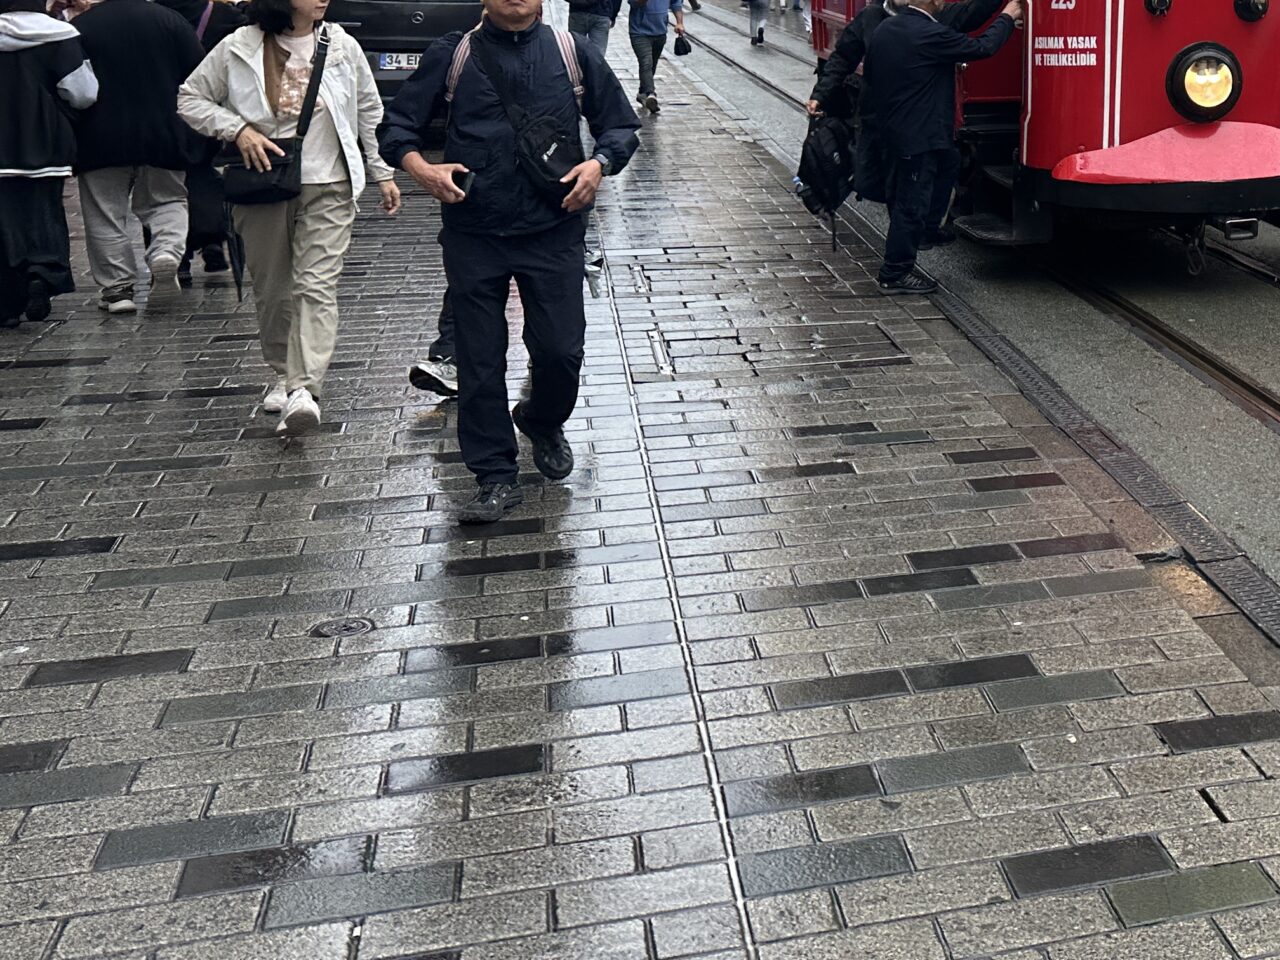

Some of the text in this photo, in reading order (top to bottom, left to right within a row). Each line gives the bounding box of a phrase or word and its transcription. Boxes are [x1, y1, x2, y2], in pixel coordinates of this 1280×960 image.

[1034, 36, 1097, 49] ASILMAK YASAK
[386, 54, 401, 65] 34
[1034, 51, 1097, 66] VE TEHLİKELİDİR
